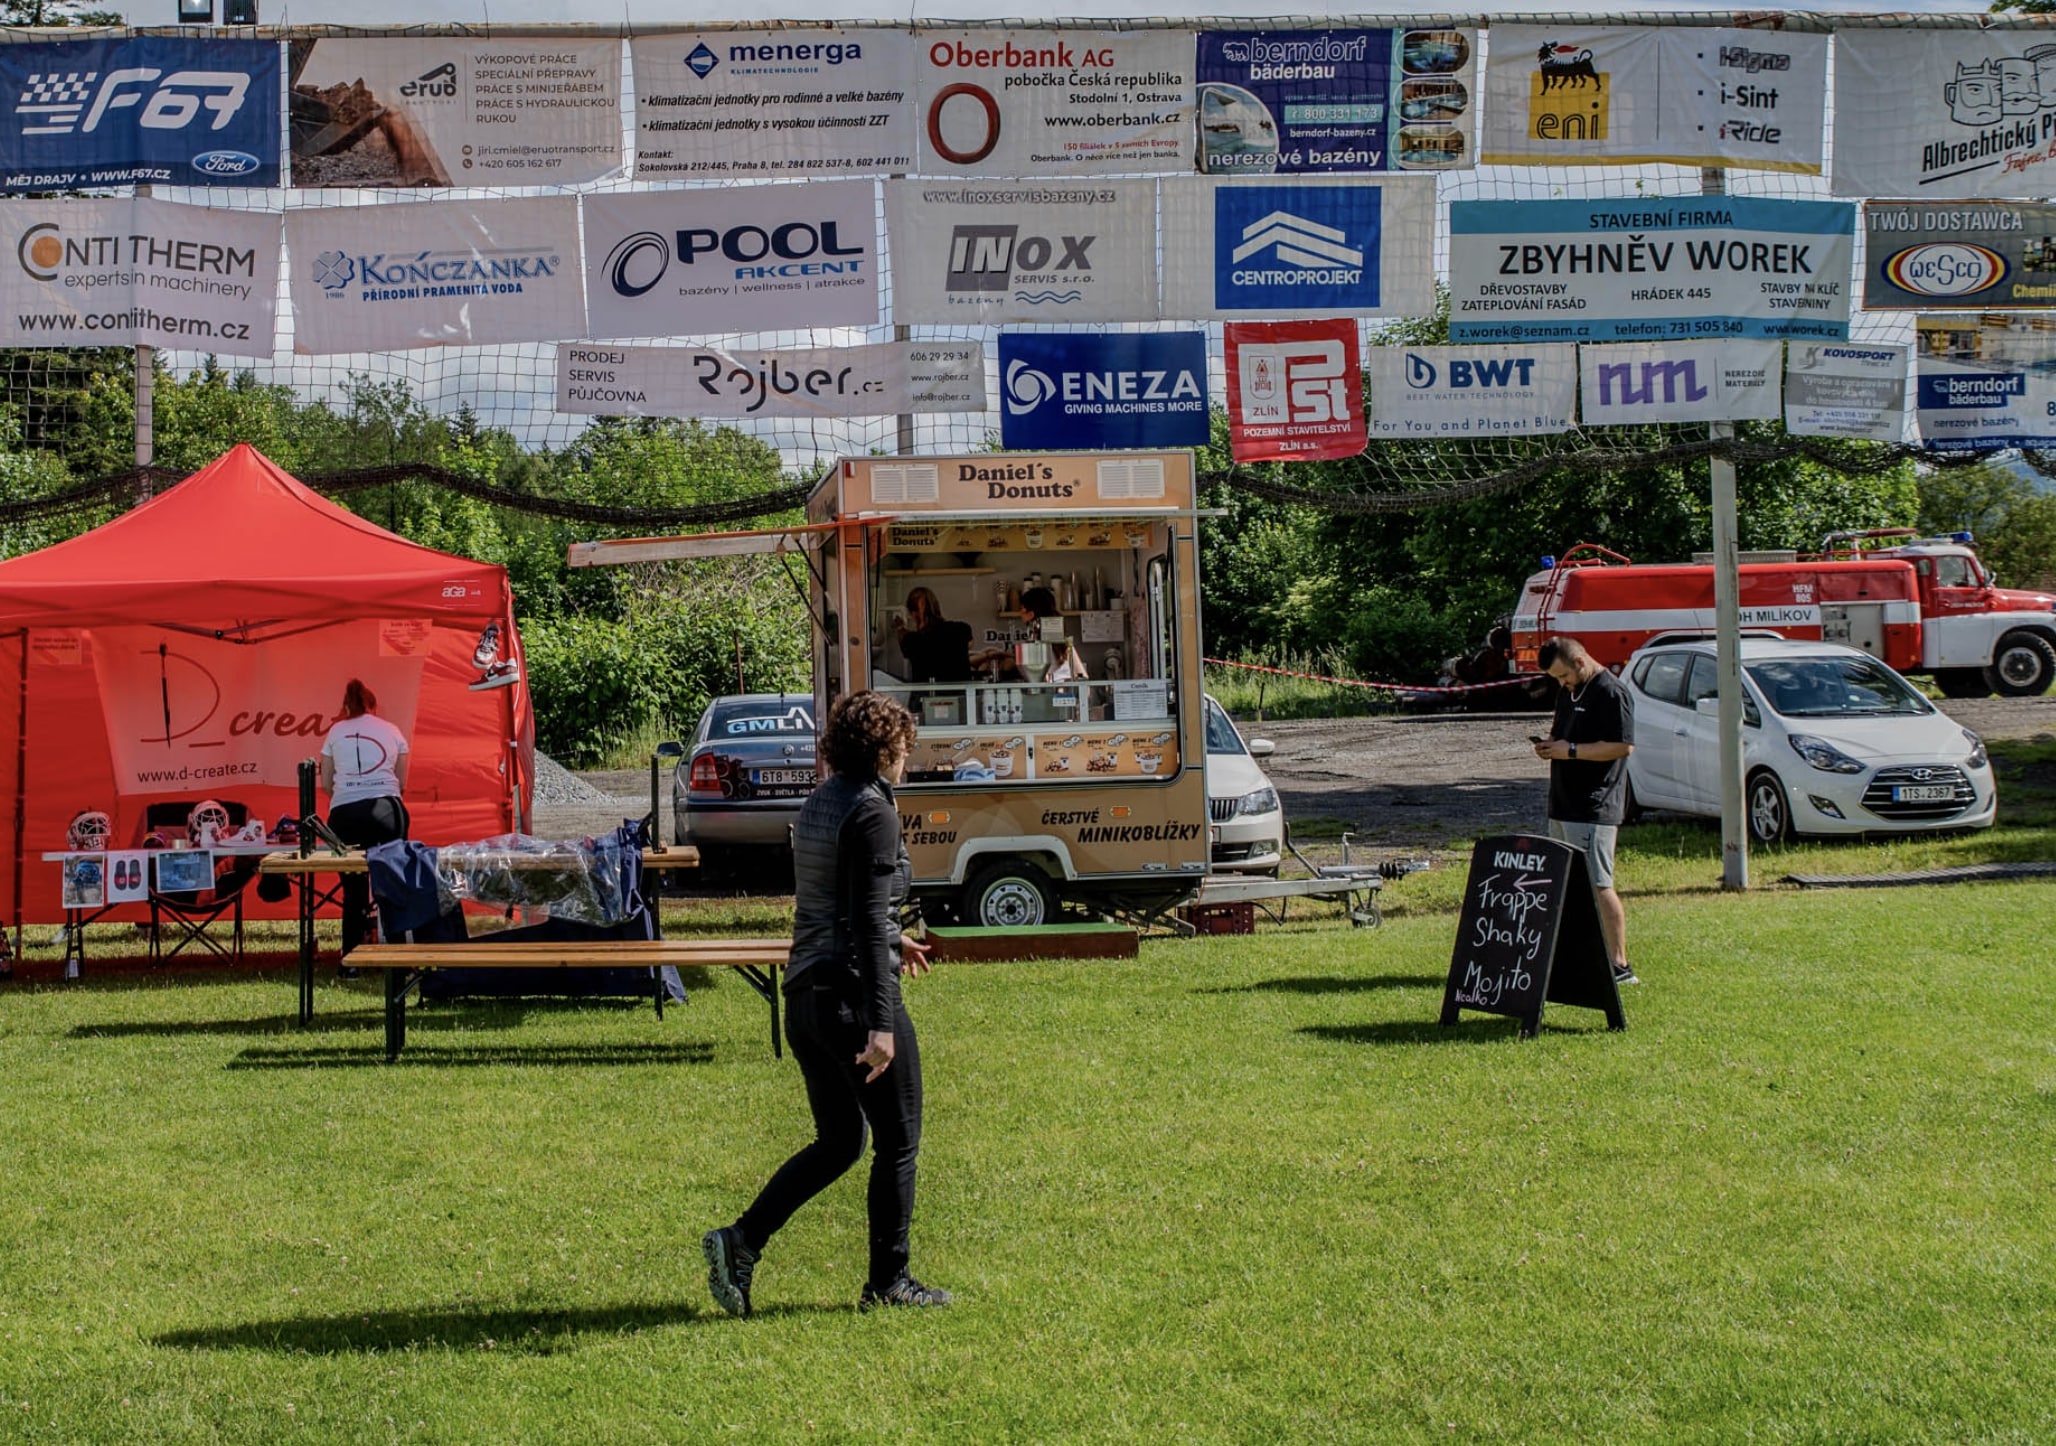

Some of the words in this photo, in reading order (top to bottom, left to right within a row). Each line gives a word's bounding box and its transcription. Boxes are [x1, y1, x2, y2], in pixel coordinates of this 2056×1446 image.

[730, 43, 862, 65] menerga
[929, 41, 1073, 68] Oberbank
[1082, 49, 1114, 67] AG
[1250, 35, 1367, 63] berndorf
[475, 52, 537, 65] VÝKOPOVÉ
[540, 52, 577, 64] PRÁCE
[475, 68, 534, 79] SPECIÁLNÍ
[537, 67, 596, 79] PŘEPRAVY
[730, 67, 819, 75] KLIMATECHNOLOGIE
[1250, 62, 1335, 80] bäderbau
[475, 82, 513, 94] PRÁCE
[516, 84, 524, 94] S
[526, 82, 604, 93] MINIJEŘÁBEM
[1004, 72, 1065, 91] pobočka
[1068, 69, 1111, 86] Česká
[1114, 72, 1182, 89] republika
[82, 68, 251, 133] F67
[476, 97, 513, 109] PRÁCE
[516, 99, 524, 108] S
[526, 98, 615, 108] HYDRAULICKOU
[648, 93, 712, 107] klimatizační
[714, 92, 760, 107] jednotky
[762, 95, 780, 105] pro
[782, 91, 823, 104] rodinné
[825, 94, 833, 103] a
[834, 91, 864, 103] velké
[866, 90, 905, 104] bazény
[1069, 92, 1118, 104] Stodolní
[1136, 92, 1182, 103] Ostrava
[1720, 82, 1779, 109] i-Sint
[476, 114, 517, 123] RUKOU
[1044, 112, 1180, 127] www.oberbank.cz
[1304, 108, 1326, 120] 800
[1329, 108, 1351, 119] 331
[1356, 107, 1378, 119] 173
[1536, 101, 1600, 140] eni
[648, 117, 713, 132] klimatizační
[714, 117, 761, 131] jednotky
[762, 120, 769, 129] s
[772, 116, 816, 130] vysokou
[868, 114, 890, 126] ZZT
[1922, 118, 2037, 172] Albrechtický
[204, 153, 247, 172] Ford
[479, 159, 503, 169] +420
[506, 159, 525, 168] 605
[527, 159, 543, 168] 162
[546, 158, 562, 168] 617
[638, 150, 674, 160] Kontakt:
[1208, 149, 1302, 166] nerezové
[1308, 148, 1382, 166] bazény
[638, 162, 689, 173] Sokolovská
[690, 161, 730, 173] 212/445,
[732, 161, 758, 171] Praha
[771, 160, 785, 170] tel.
[787, 160, 804, 169] 284
[806, 159, 823, 168] 822
[856, 158, 873, 167] 602
[875, 157, 891, 167] 441
[893, 157, 909, 166] 011
[5, 174, 32, 187] MĚJ
[34, 172, 77, 186] DRAJV
[90, 168, 171, 183] WWW.F67.CZ
[923, 188, 1116, 205] www.inoxservisbazeny.cz
[1589, 208, 1673, 229] STAVEBNÍ
[1677, 209, 1733, 227] FIRMA
[1869, 206, 1919, 231] TWÓJ
[1925, 211, 2024, 231] DOSTAWCA
[676, 221, 864, 264] POOL
[128, 235, 255, 277] THERM
[1499, 235, 1675, 274] ZBYHNĚV
[1686, 239, 1812, 273] WOREK
[735, 260, 865, 280] AKCENT
[1231, 269, 1363, 286] CENTROPROJEKT
[150, 274, 252, 301] machinery
[679, 285, 730, 296] bazény
[742, 281, 802, 293] wellness
[814, 277, 866, 289] atrakce
[1014, 274, 1057, 284] SERVIS
[1062, 275, 1095, 284] s.r.o.
[362, 287, 420, 302] PŘÍRODNÍ
[423, 284, 489, 299] PRAMENITÁ
[491, 282, 523, 295] VODA
[1479, 281, 1567, 296] DŘEVOSTAVBY
[1631, 285, 1684, 301] HRÁDEK
[1686, 287, 1711, 299] 445
[1760, 282, 1801, 294] STAVBY
[1817, 282, 1840, 296] KLÍČ
[1461, 296, 1543, 312] ZATEPLOVÁNÍ
[1546, 296, 1587, 311] FASÁD
[1459, 326, 1590, 338] z.worek@seznam.cz
[1615, 323, 1667, 336] telefon:
[1669, 321, 1692, 334] 731
[1694, 321, 1720, 333] 505
[569, 350, 625, 365] PRODEJ
[910, 352, 927, 362] 606
[929, 352, 941, 361] 29
[943, 352, 954, 361] 29
[957, 351, 969, 360] 34
[1823, 347, 1896, 360] KOVOSPORT
[569, 369, 615, 383] SERVIS
[911, 373, 969, 384] www.rojber.cz
[1449, 358, 1535, 388] BWT
[568, 385, 647, 402] PŮJČOVNA
[1062, 370, 1201, 400] ENEZA
[1949, 377, 2019, 393] berndorf
[912, 392, 971, 403] info@rojber.cz
[1406, 393, 1430, 401] BEST
[1433, 393, 1467, 401] WATER
[1469, 391, 1535, 400] TECHNOLOGY
[1948, 394, 2002, 405] bäderbau
[1064, 402, 1102, 415] GIVING
[1105, 402, 1165, 414] MACHINES
[1167, 400, 1202, 412] MORE
[1252, 405, 1279, 416] ZLÍN
[1243, 425, 1284, 437] POZEMNÍ
[1287, 422, 1351, 436] STAVITELSTVÍ
[1373, 420, 1398, 431] For
[1404, 420, 1432, 431] You
[1441, 418, 1469, 430] and
[1477, 417, 1527, 430] Planet
[1279, 440, 1300, 451] ZLÍN
[1756, 608, 1812, 622] MILÍKOV
[137, 760, 258, 783] www.d-create.cz
[761, 770, 783, 783] 6T8
[1902, 787, 1920, 799] 1TS
[1927, 786, 1950, 799] 2367
[1041, 808, 1100, 825] ČERSTVÉ
[911, 831, 957, 845] SEBOU
[1077, 818, 1200, 843] MINIKOBLÍŽKY
[1477, 874, 1548, 922] Frappe
[1472, 915, 1542, 960] Shaky
[1463, 955, 1532, 1005] Mojito
